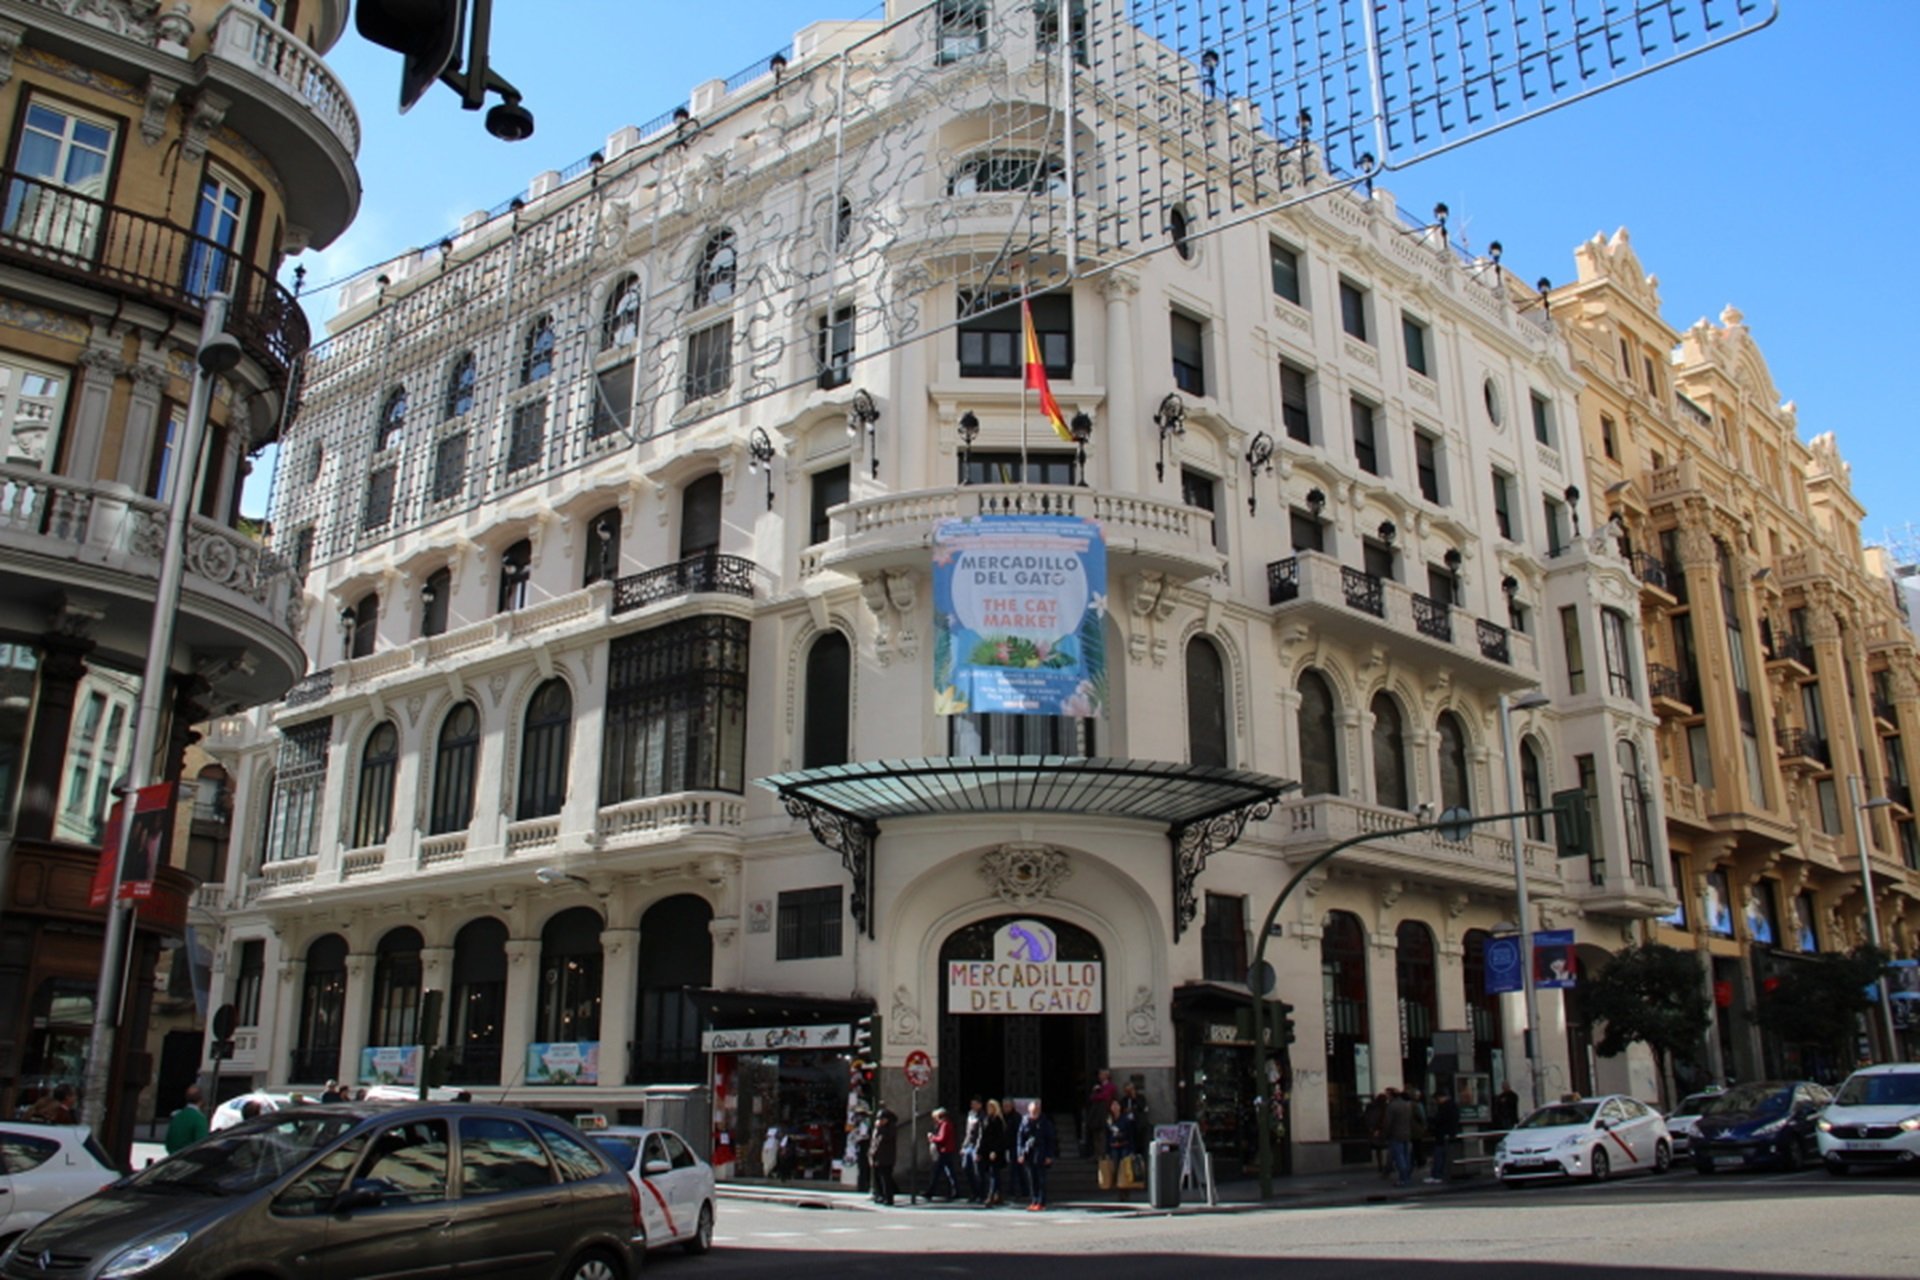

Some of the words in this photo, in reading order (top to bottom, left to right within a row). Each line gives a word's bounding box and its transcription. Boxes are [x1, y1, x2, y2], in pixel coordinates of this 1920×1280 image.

[961, 556, 1078, 571] MERCADILLO
[974, 571, 1007, 585] DEL
[1015, 572, 1065, 586] GATO
[983, 599, 1017, 612] THE
[1025, 600, 1057, 612] CAT
[983, 615, 1057, 628] MARKET
[971, 990, 1018, 1010] DEL
[1030, 989, 1092, 1011] GATO
[65, 1153, 76, 1166] L
